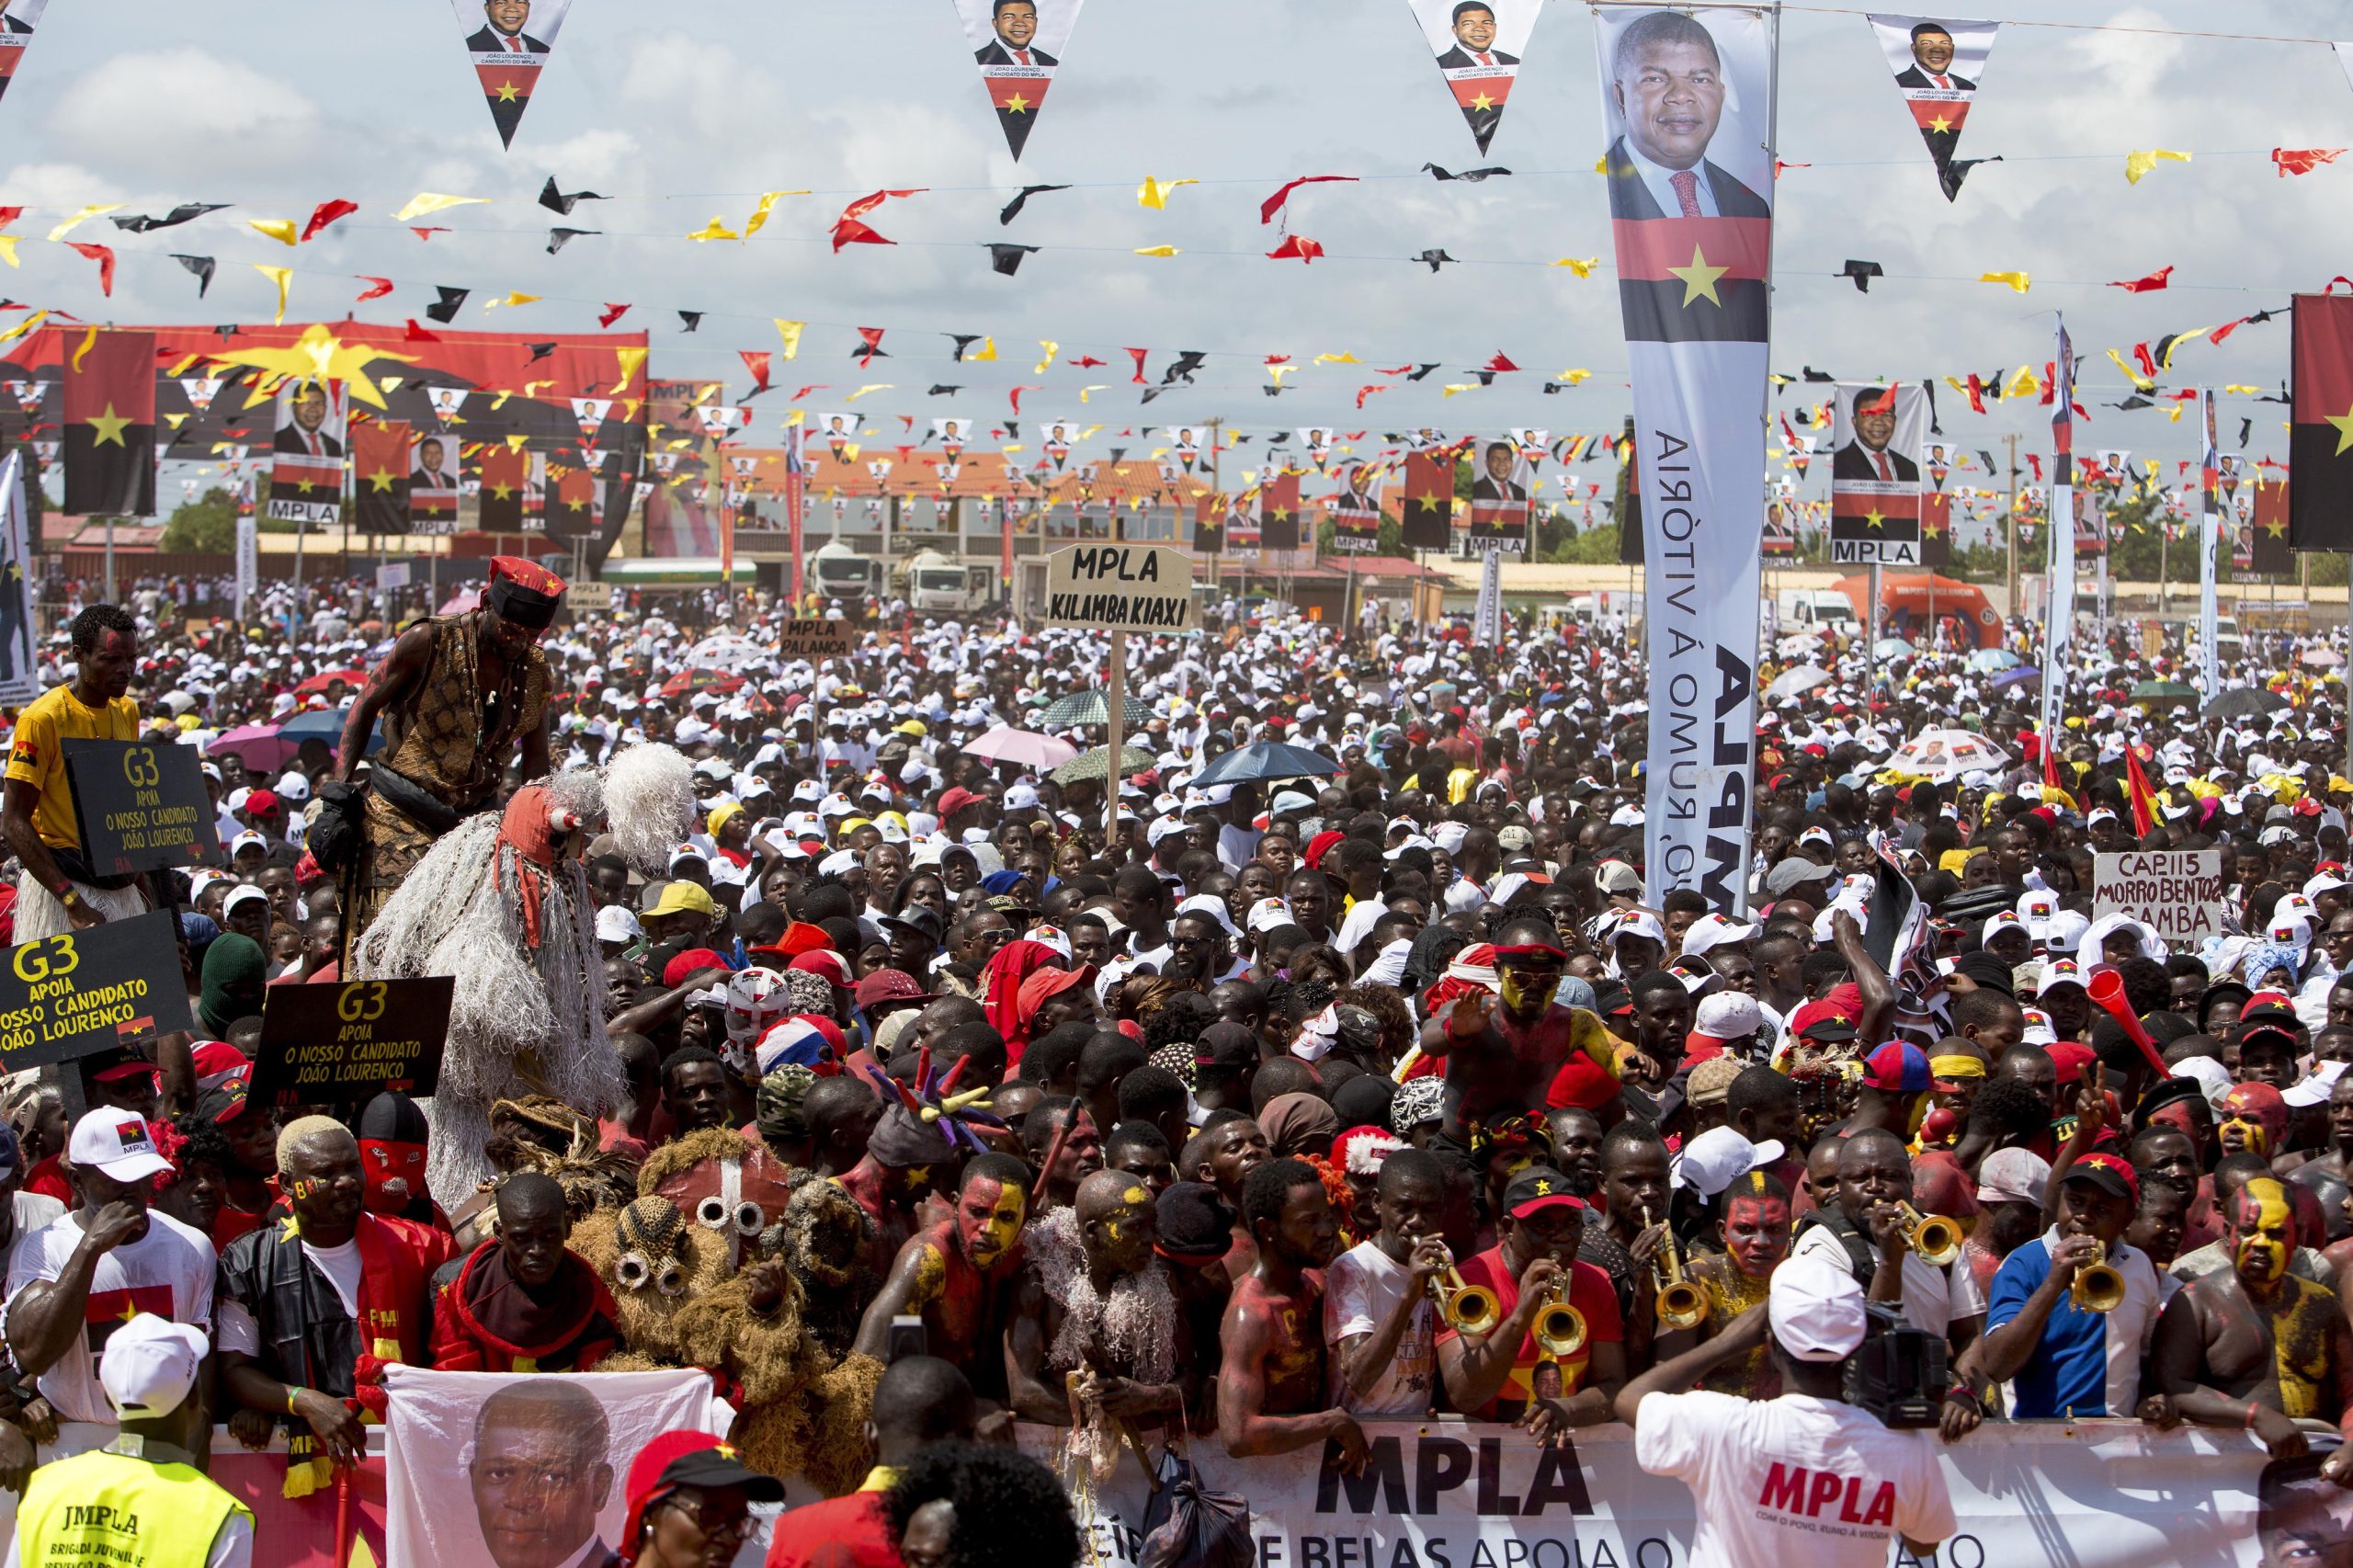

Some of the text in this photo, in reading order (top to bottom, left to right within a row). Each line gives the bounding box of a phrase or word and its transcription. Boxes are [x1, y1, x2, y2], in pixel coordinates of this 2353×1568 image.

[271, 502, 335, 521] MPLA
[412, 521, 456, 534] MPLA
[1336, 536, 1377, 551] MPLA
[1472, 538, 1526, 553] MPLA
[1835, 541, 1915, 563] MPLA
[1072, 548, 1158, 582] MPLA
[1050, 593, 1188, 627] KILAMBA KIAXI
[788, 621, 836, 636] MPLA
[780, 639, 847, 654] PALANCA
[123, 747, 160, 788] G3
[136, 790, 161, 808] APOIA
[106, 806, 199, 831] O NOSSO CANDIDATO
[122, 828, 145, 851] JOÃO
[2096, 880, 2158, 903] MORRO
[2310, 886, 2321, 897] MPLA
[13, 934, 80, 983] G3
[29, 977, 75, 1004] APOIA
[1100, 976, 1110, 994] MPLA
[55, 978, 148, 1017] CANDIDATO
[337, 981, 388, 1022] G3
[43, 1003, 135, 1041] LOURENÇO
[337, 1024, 372, 1042] APOIA
[285, 1040, 421, 1064] O NOSSO CANDIDATO
[296, 1063, 329, 1085] JOÃO
[232, 1091, 247, 1102] MPL
[123, 1142, 151, 1154] MPLA
[1730, 1160, 1753, 1180] MPLA
[1315, 1436, 1595, 1516] MPLA
[1759, 1461, 1896, 1528] MPLA
[63, 1506, 138, 1536] JMPLA
[1756, 1510, 1778, 1523] COM
[1779, 1517, 1789, 1526] O
[1819, 1524, 1848, 1536] RUMO
[95, 1544, 133, 1563] JUVENIL
[1301, 1536, 1452, 1568] BELAS
[1471, 1538, 1622, 1568] APOIA
[1637, 1538, 1673, 1568] O
